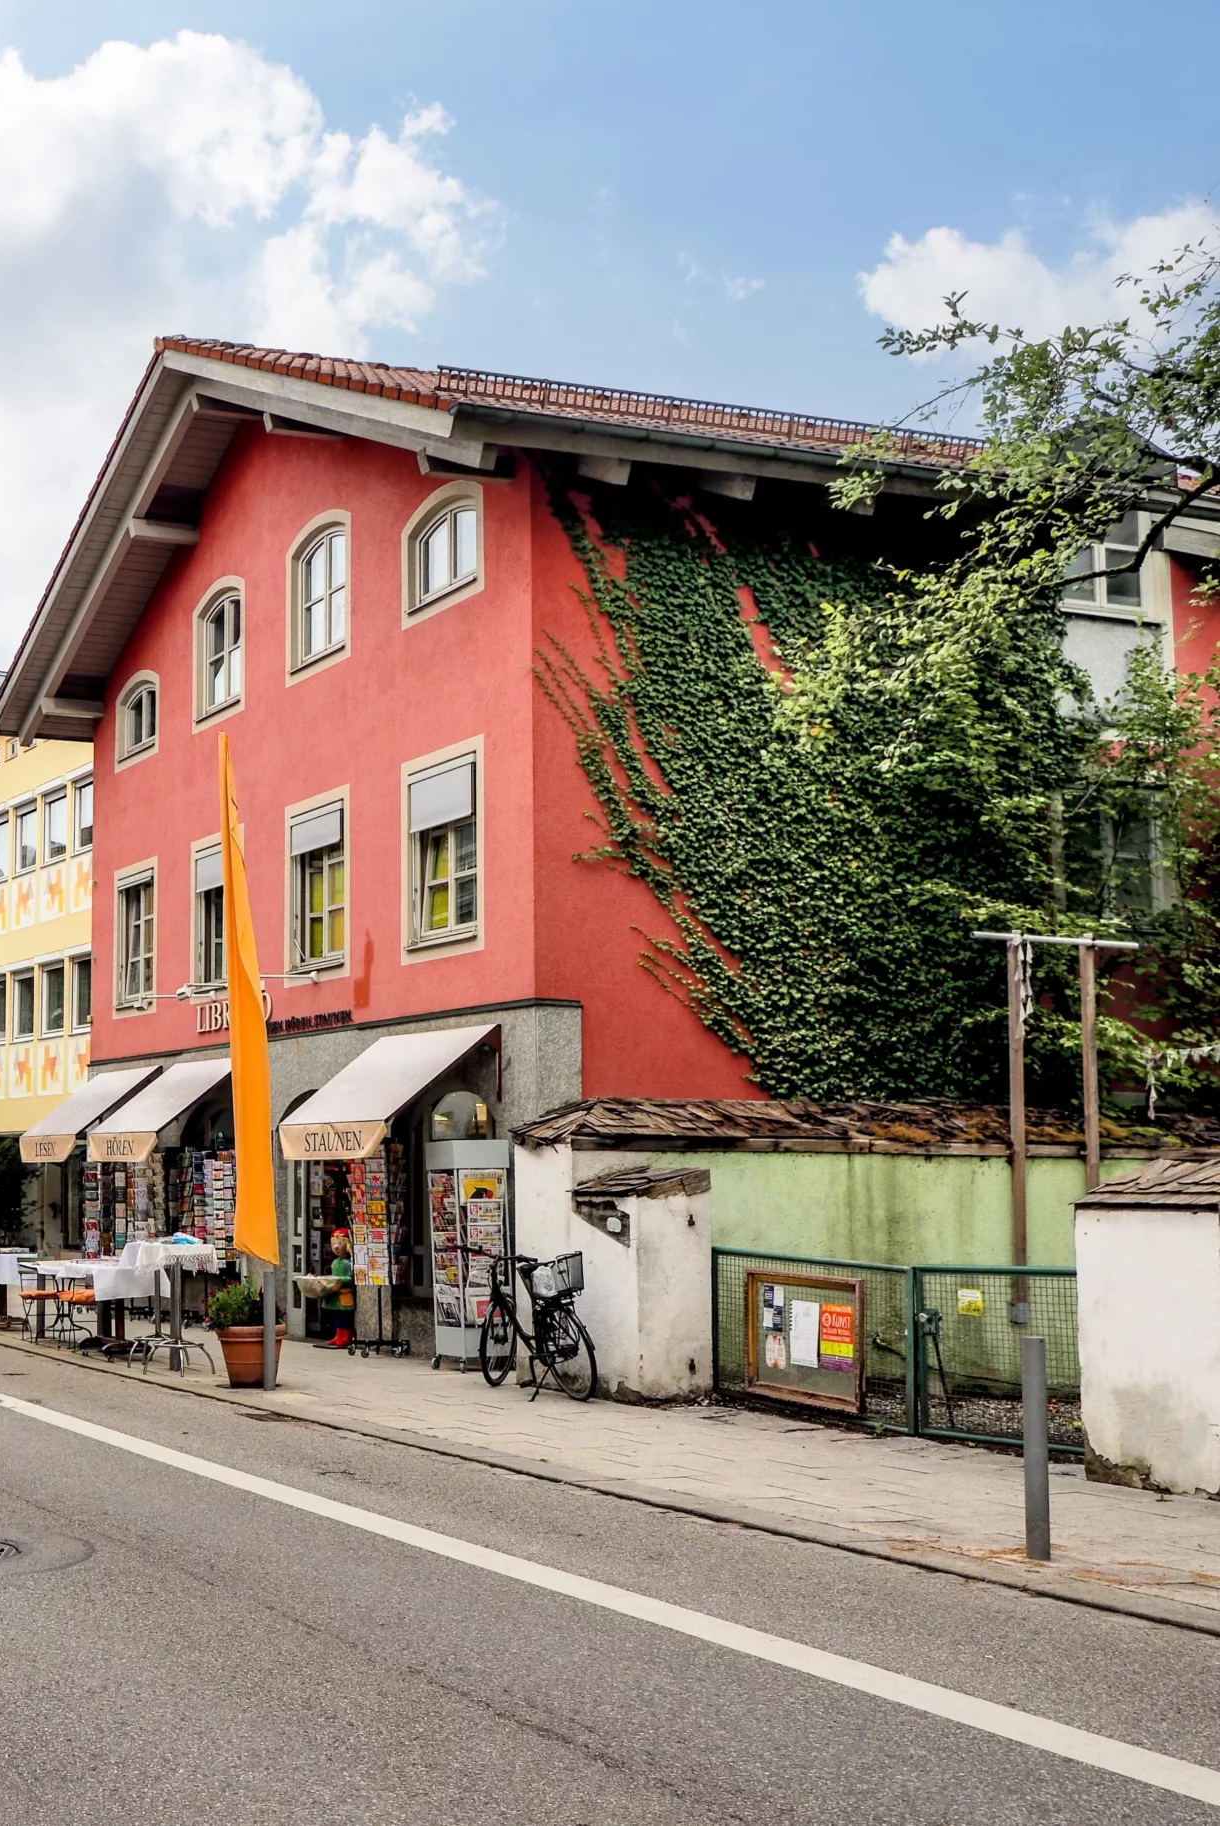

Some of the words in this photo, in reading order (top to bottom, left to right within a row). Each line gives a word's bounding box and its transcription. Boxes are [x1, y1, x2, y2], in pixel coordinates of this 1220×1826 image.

[35, 1142, 57, 1157] LESEN.
[106, 1137, 135, 1156] HÖREN.
[304, 1131, 364, 1152] STAUNEN.
[831, 1313, 851, 1328] KUNST
